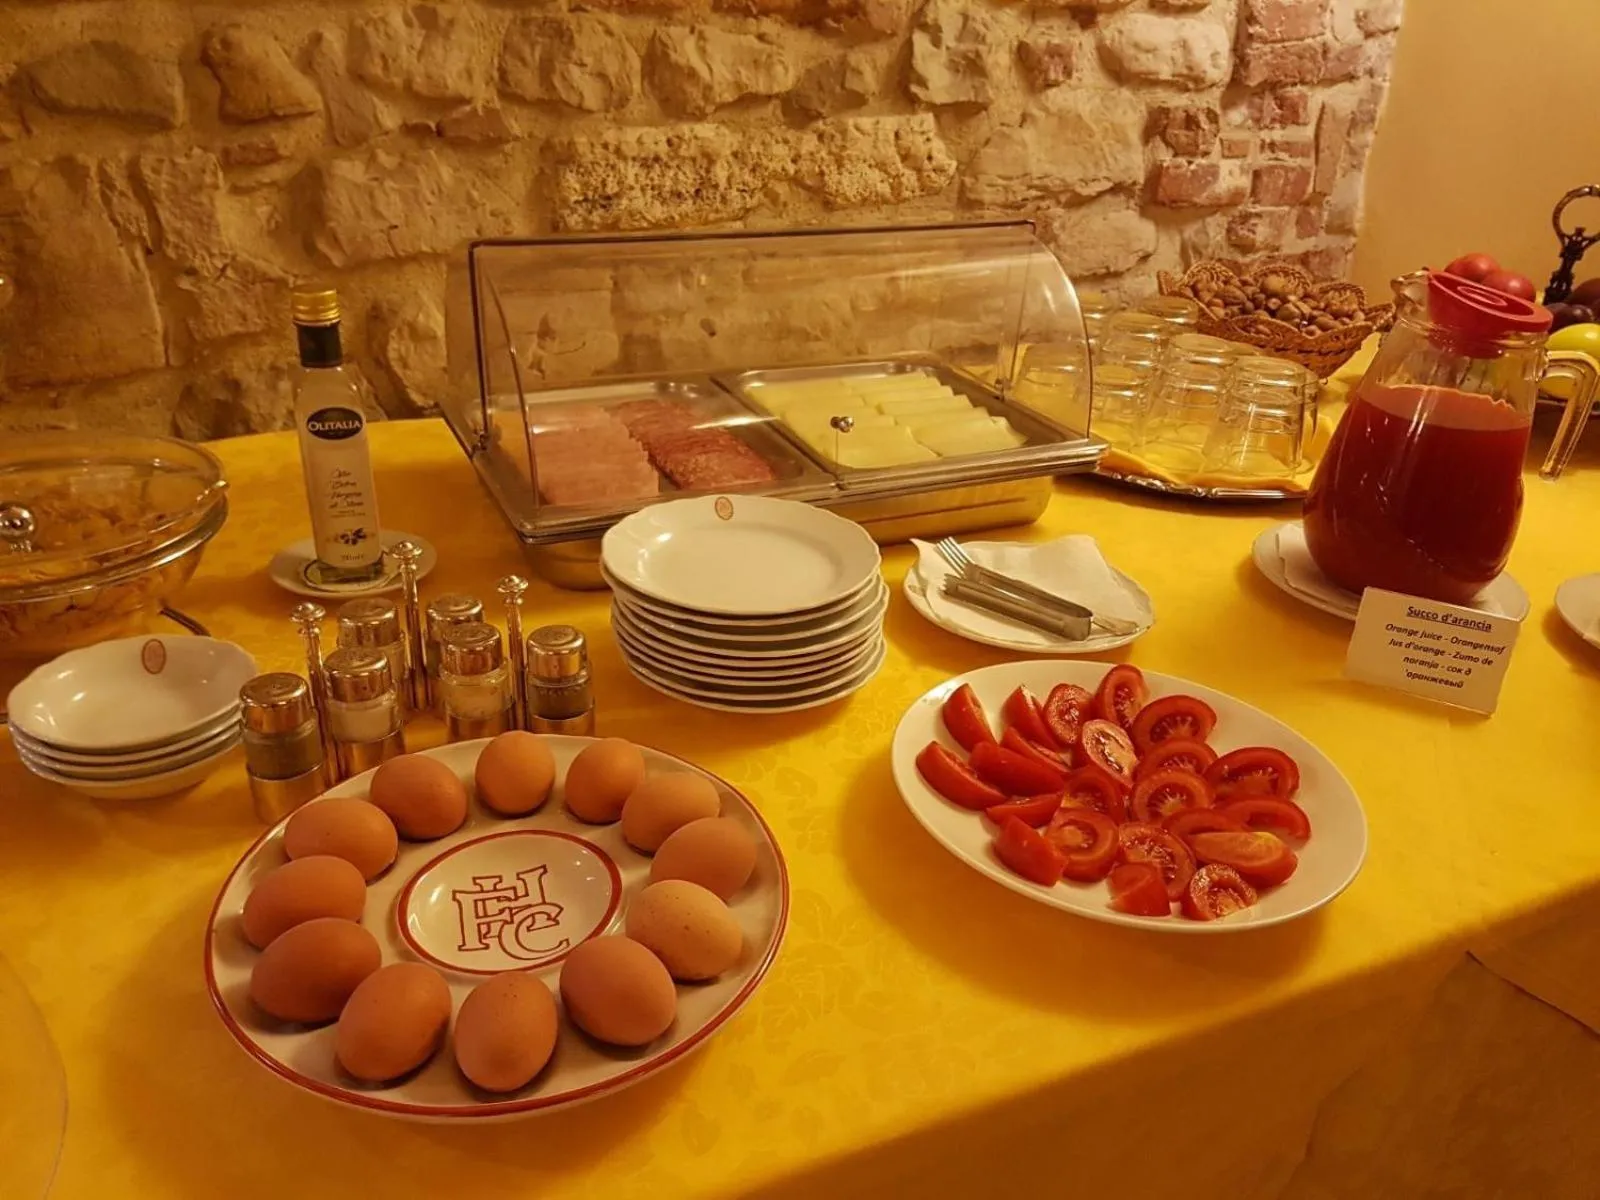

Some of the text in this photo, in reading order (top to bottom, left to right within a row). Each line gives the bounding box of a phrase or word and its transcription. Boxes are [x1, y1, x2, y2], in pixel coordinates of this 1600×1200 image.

[309, 420, 361, 431] OLITALIA
[1407, 606, 1492, 631] Succo d'arancia
[1385, 623, 1419, 637] Orange
[1404, 640, 1446, 657] d'orange
[1481, 656, 1494, 666] de
